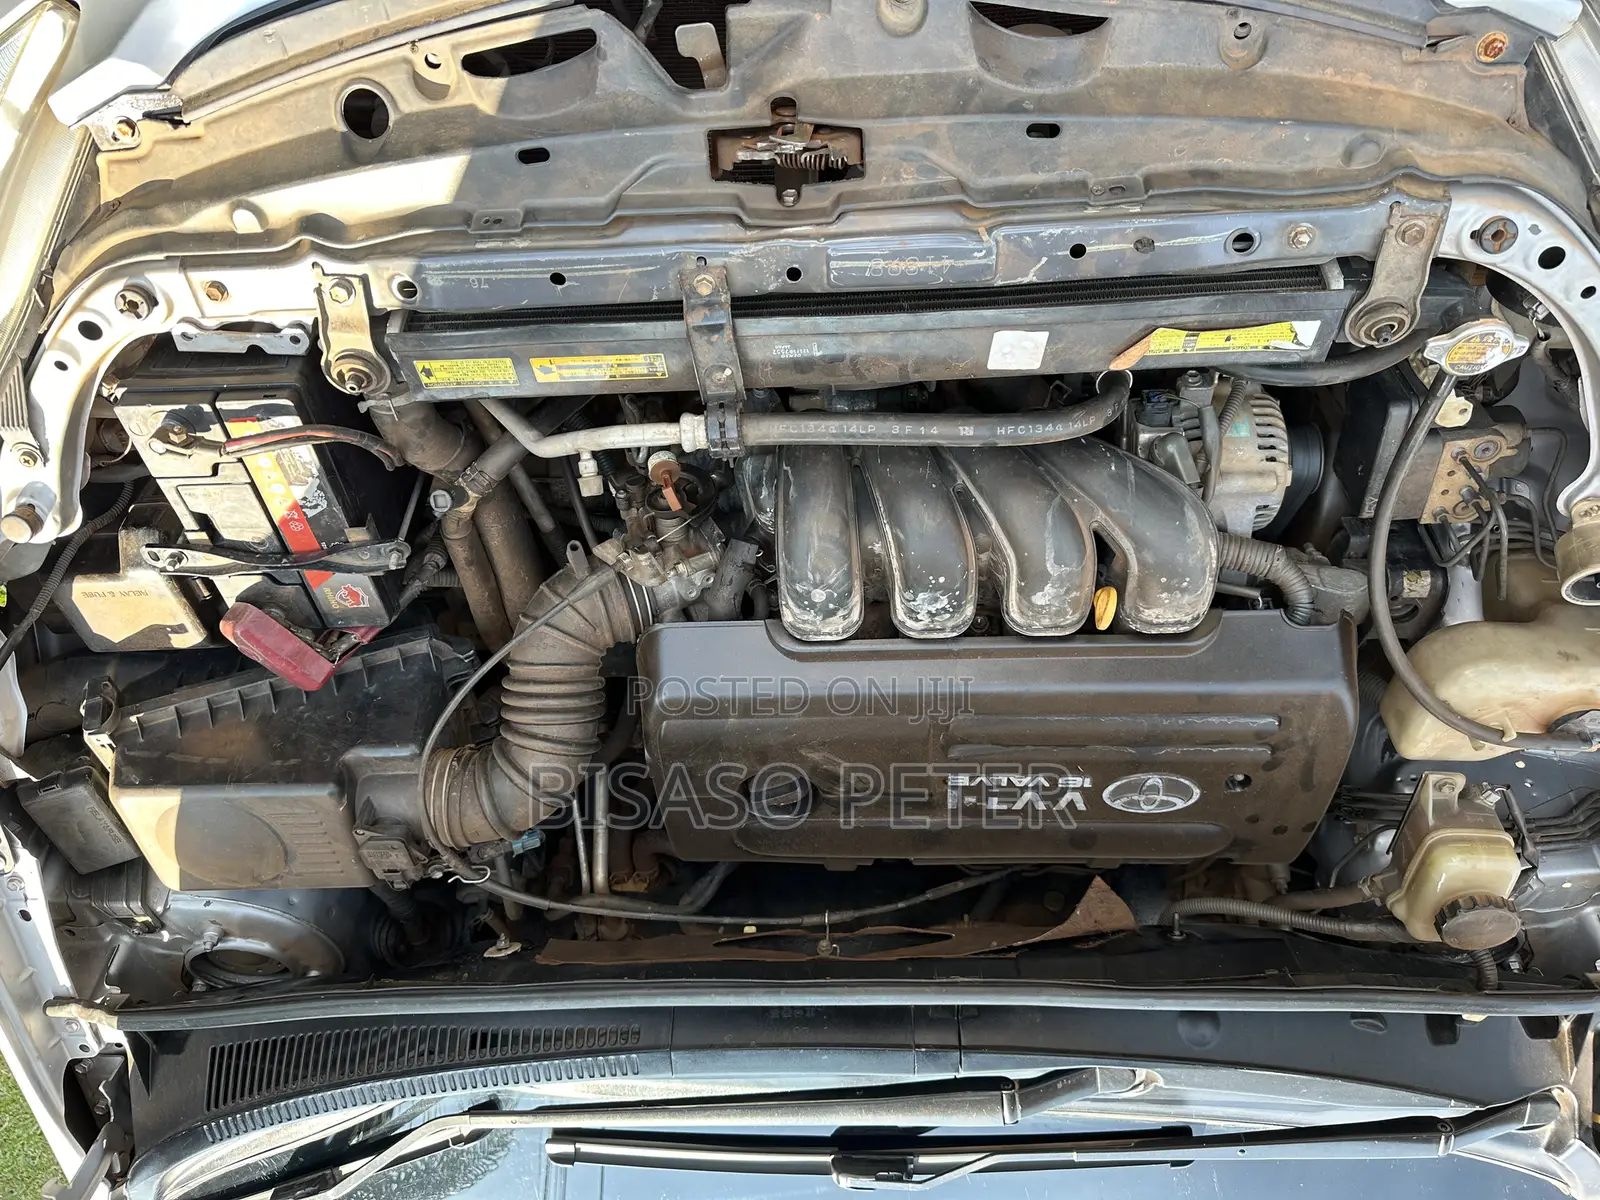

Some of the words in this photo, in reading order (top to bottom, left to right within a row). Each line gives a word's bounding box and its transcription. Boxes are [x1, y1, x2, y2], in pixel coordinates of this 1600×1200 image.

[842, 424, 877, 434] 14LP
[118, 589, 149, 598] RELAY
[323, 587, 340, 609] RHINO
[947, 774, 1050, 788] VALVE
[1057, 776, 1093, 788] 16
